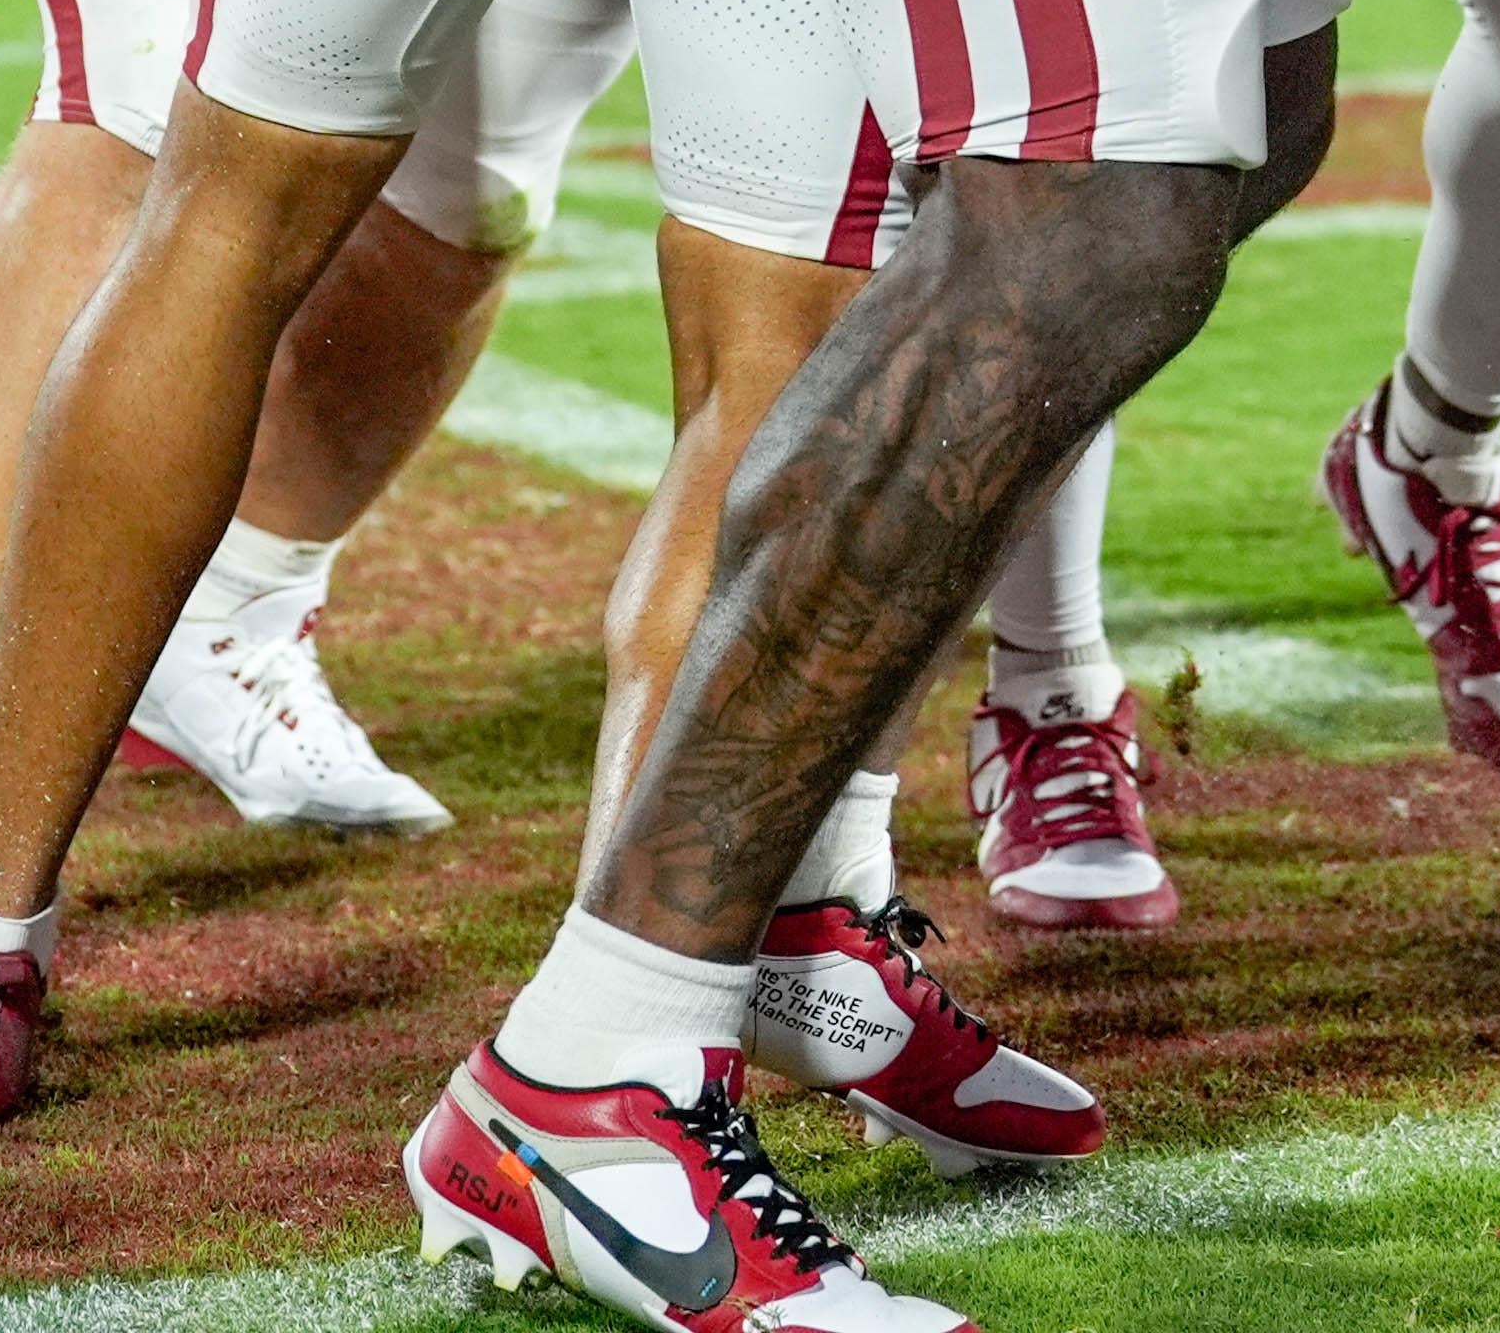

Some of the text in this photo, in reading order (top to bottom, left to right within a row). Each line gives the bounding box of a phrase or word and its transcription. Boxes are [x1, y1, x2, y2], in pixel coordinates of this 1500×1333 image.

[787, 978, 816, 999] for
[818, 989, 863, 1014] NIKE
[788, 995, 827, 1021] THE
[747, 995, 867, 1053] klahoma USA
[441, 1155, 518, 1213] "RSJ"
